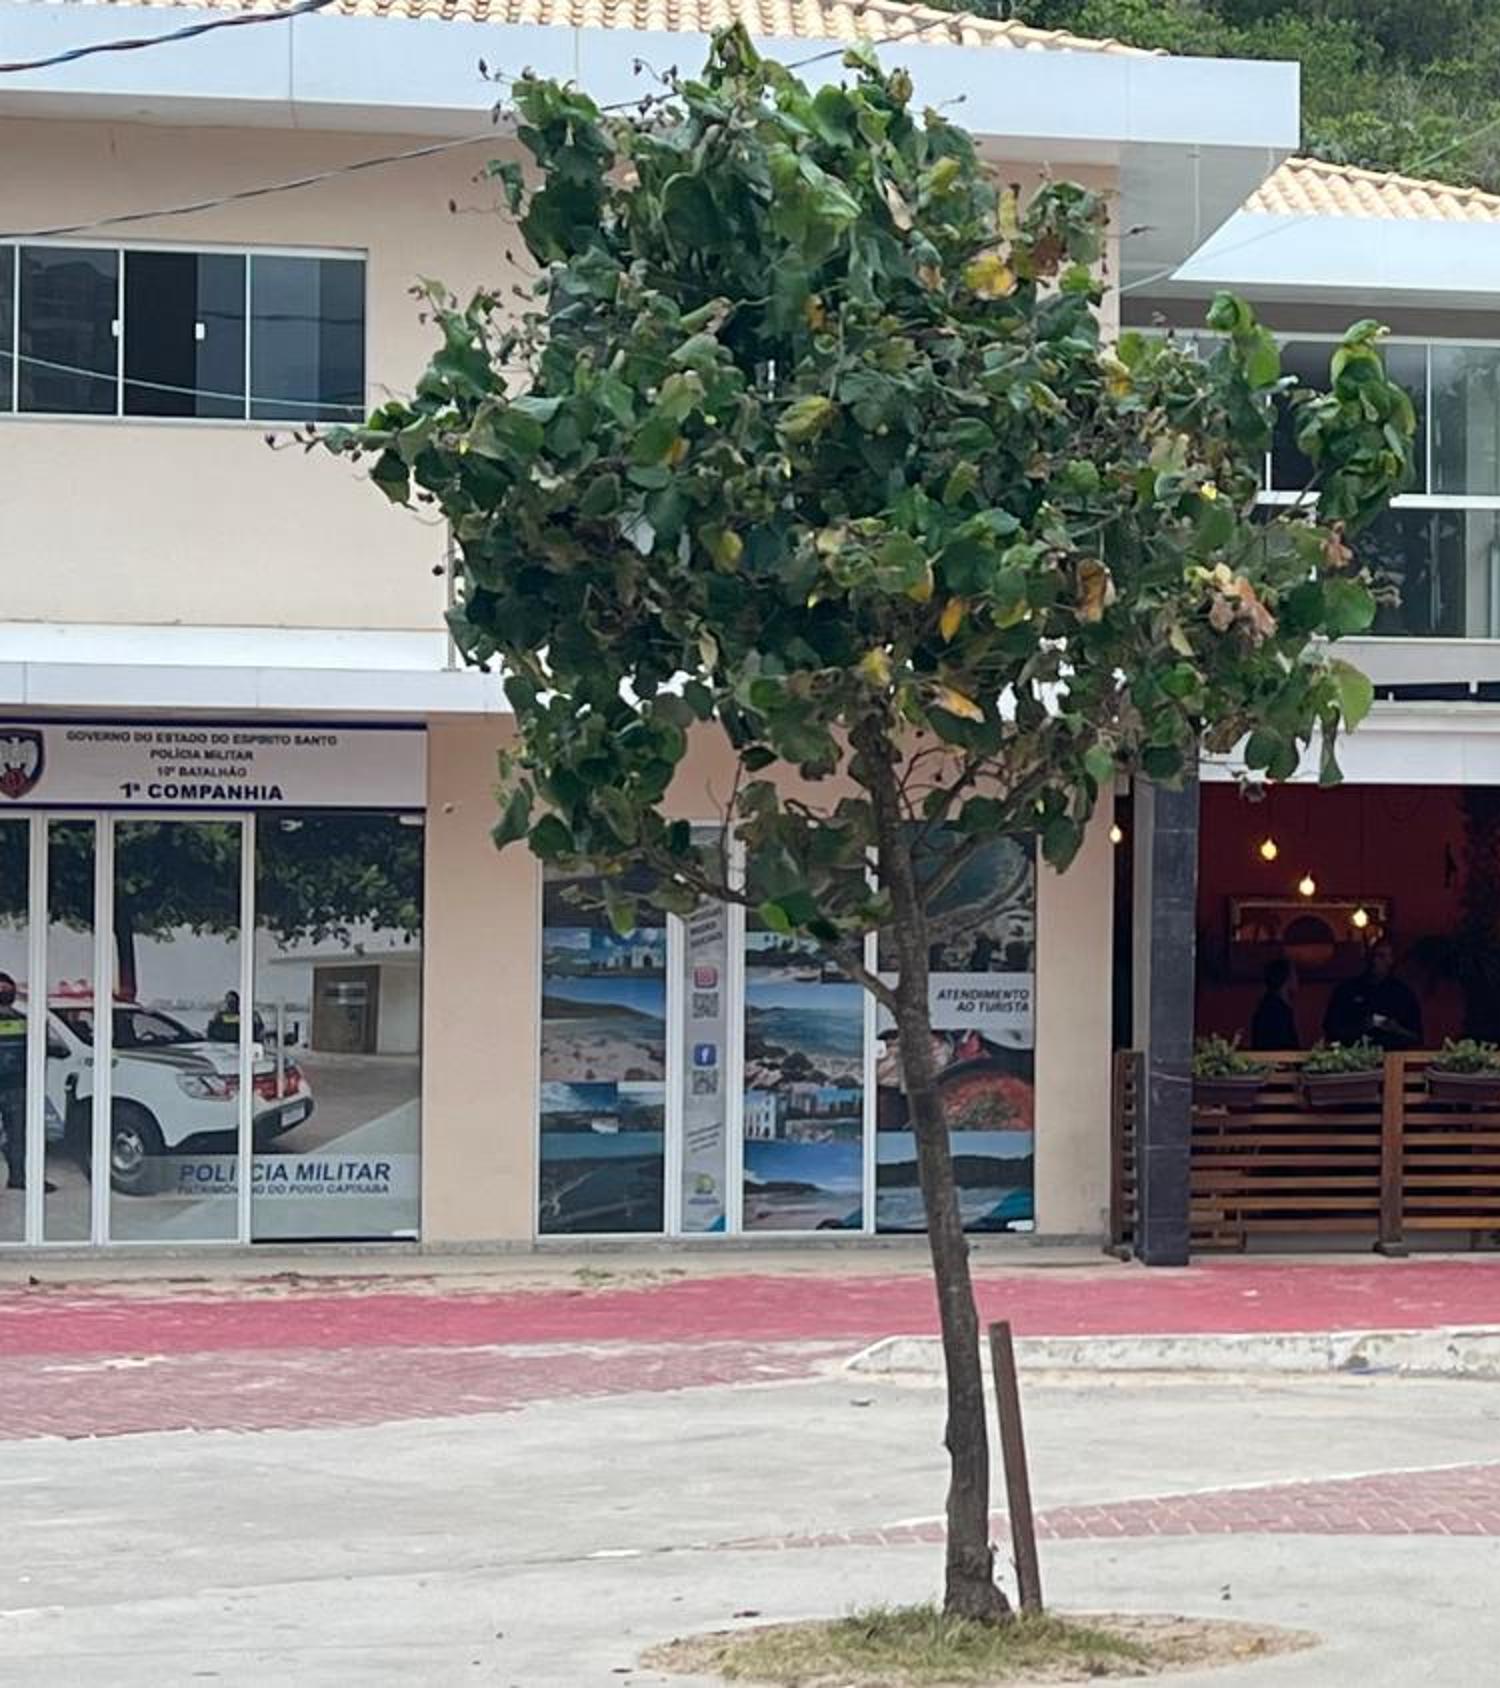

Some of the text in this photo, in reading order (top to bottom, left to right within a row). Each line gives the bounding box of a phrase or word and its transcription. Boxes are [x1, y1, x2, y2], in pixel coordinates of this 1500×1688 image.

[66, 731, 130, 741] GOVERNO
[134, 732, 152, 742] DO
[157, 732, 207, 743] ESTADO
[212, 734, 229, 744] DO
[295, 736, 337, 745] SANTO
[204, 750, 253, 760] MILITAR
[147, 784, 283, 800] COMPANHIA
[938, 989, 1030, 1001] ATENDIMENTO
[957, 1001, 1030, 1013] AO TURISTA
[295, 1163, 390, 1182] MILITAR
